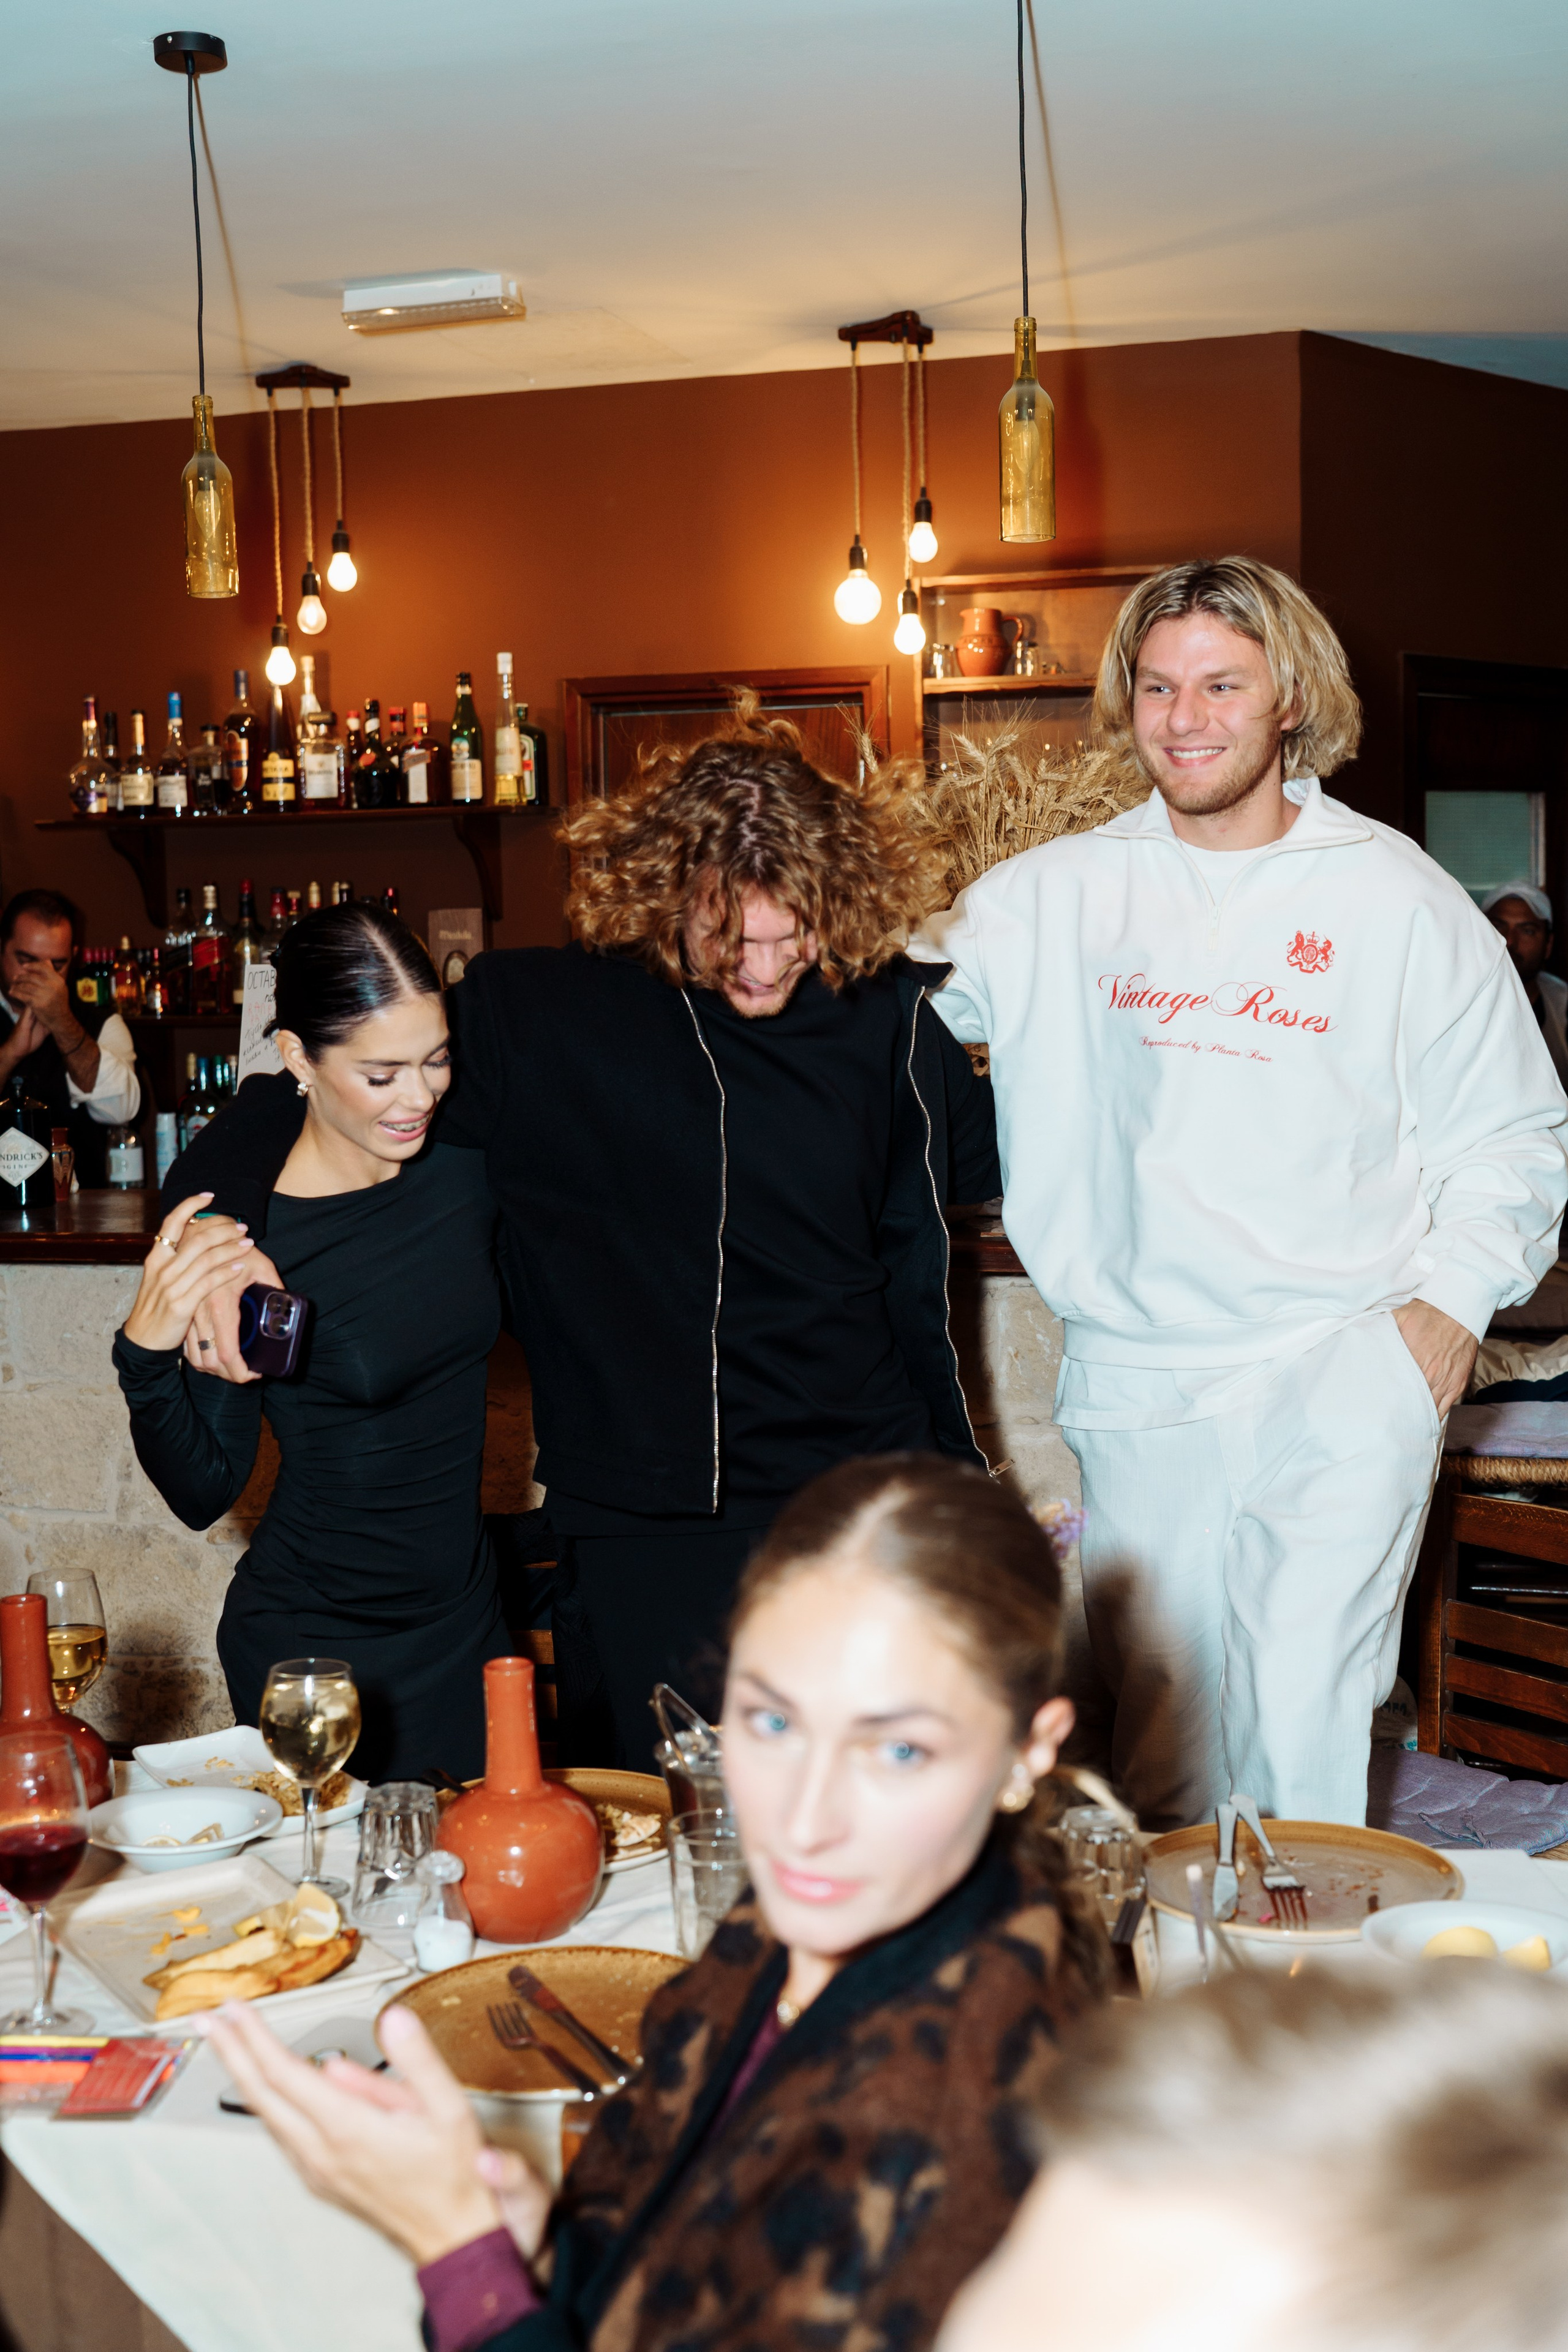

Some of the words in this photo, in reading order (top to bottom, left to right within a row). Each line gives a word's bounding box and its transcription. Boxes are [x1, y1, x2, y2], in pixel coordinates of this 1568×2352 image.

[1098, 973, 1213, 1024] Vintage
[1211, 981, 1338, 1034] Roses
[1139, 1036, 1192, 1050] Reproduced
[1191, 1041, 1202, 1054] by
[1204, 1042, 1241, 1057] Planta
[1245, 1049, 1273, 1063] Rosa
